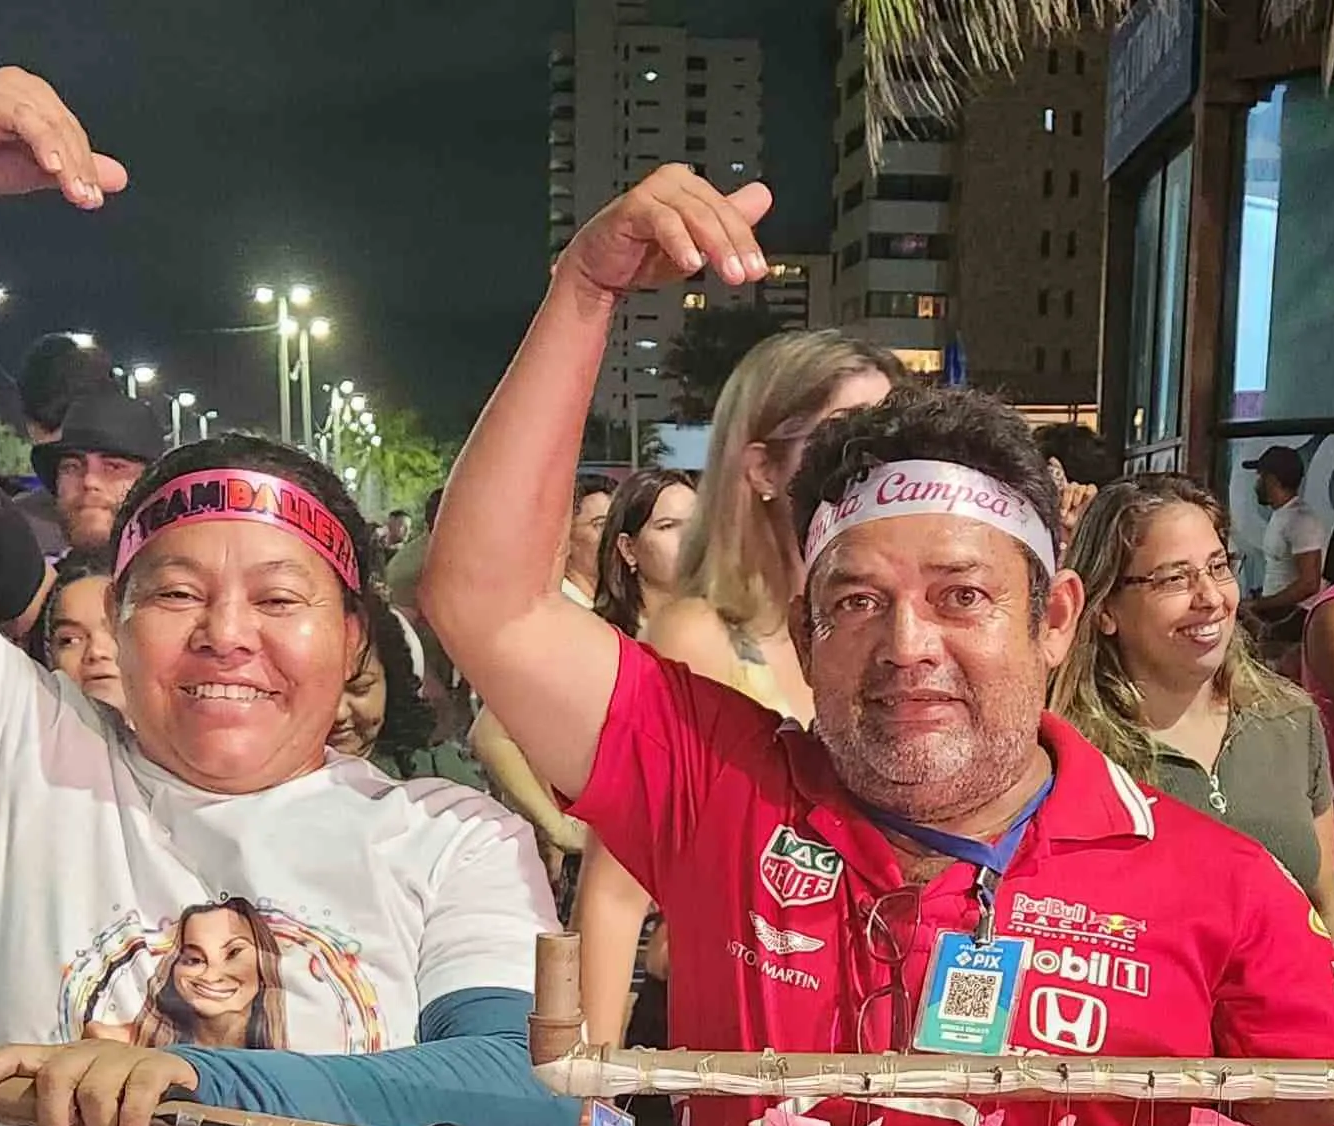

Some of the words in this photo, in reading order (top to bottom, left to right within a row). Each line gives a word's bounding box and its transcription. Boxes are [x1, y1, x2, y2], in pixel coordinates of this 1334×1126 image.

[138, 480, 226, 540] TEAM
[782, 833, 836, 872] TAG
[764, 859, 831, 898] HEUER
[1011, 911, 1137, 940] RACING
[761, 959, 821, 992] MARTIN
[972, 953, 1002, 969] PIX
[1033, 947, 1110, 987] obil
